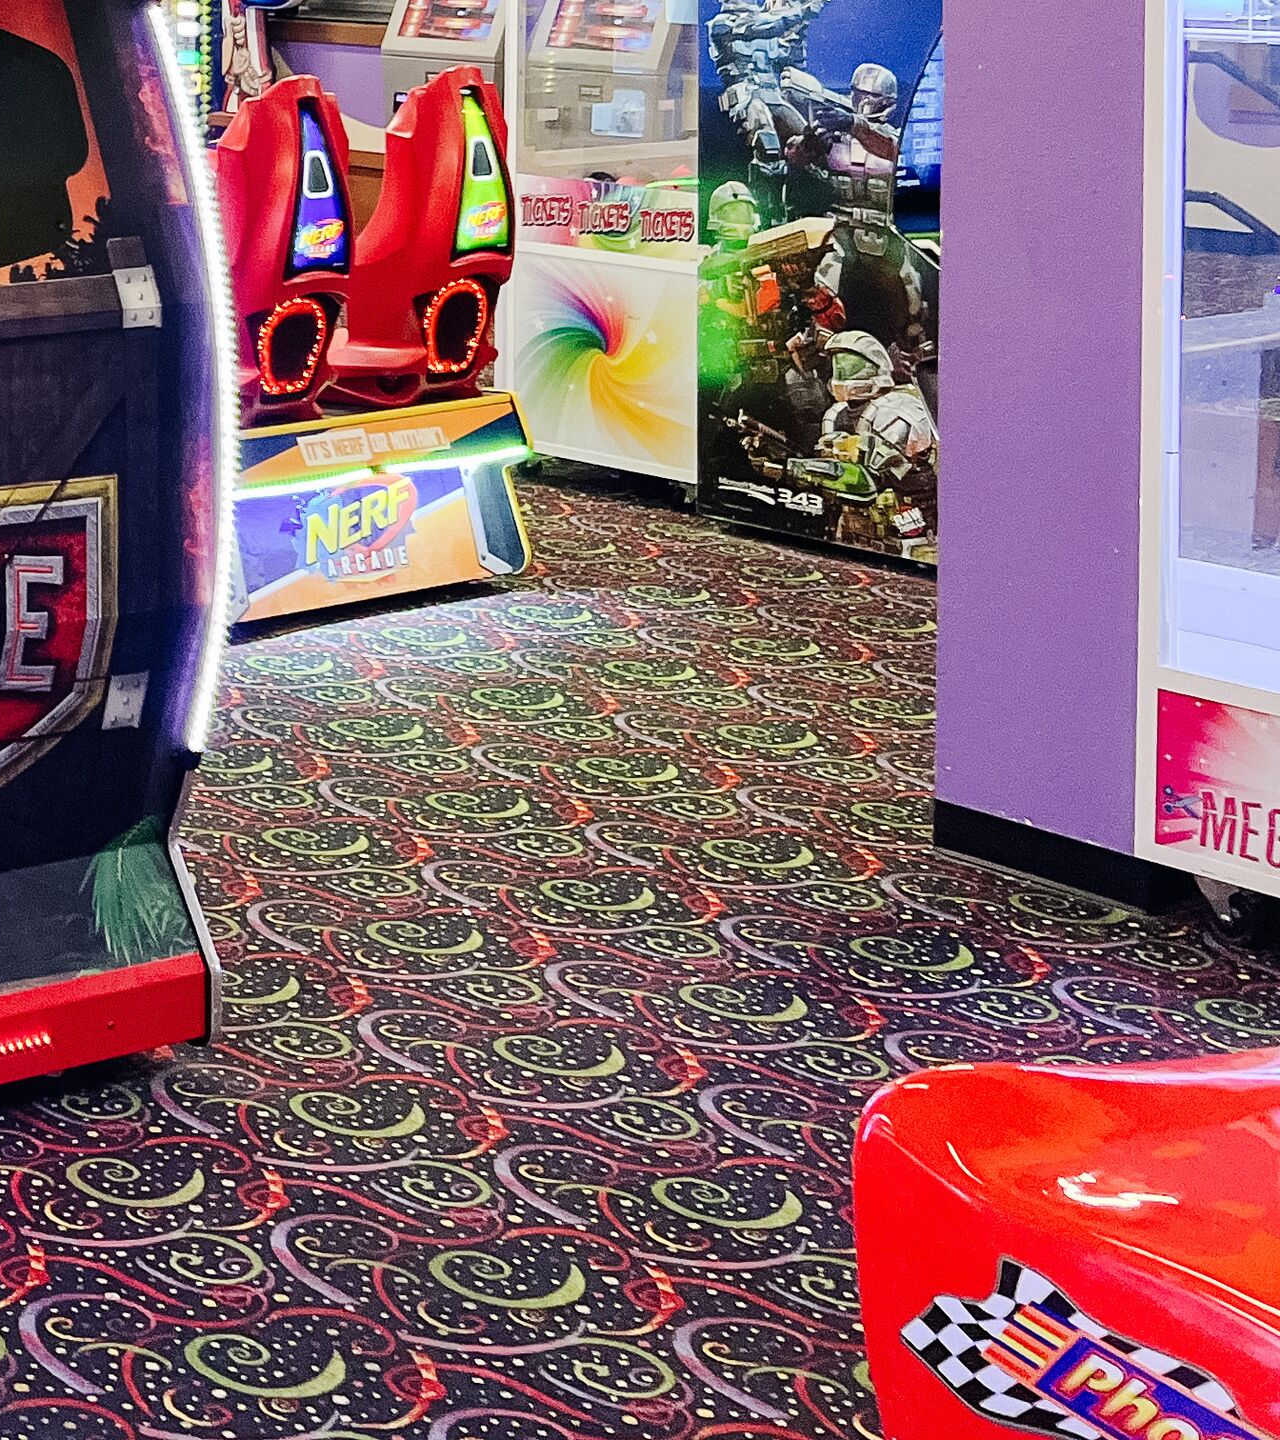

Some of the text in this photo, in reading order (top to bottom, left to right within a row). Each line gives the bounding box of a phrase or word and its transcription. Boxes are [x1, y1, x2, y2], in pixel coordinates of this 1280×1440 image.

[466, 203, 506, 230] NERF
[521, 194, 573, 226] TICKETS
[577, 200, 632, 233] TICKETS
[640, 208, 695, 242] TICKETS
[300, 222, 344, 248] NERF
[304, 440, 331, 460] IT'S
[333, 436, 366, 455] NERF
[777, 488, 823, 509] 343
[306, 476, 411, 566] NERF
[327, 545, 409, 578] ARCADE
